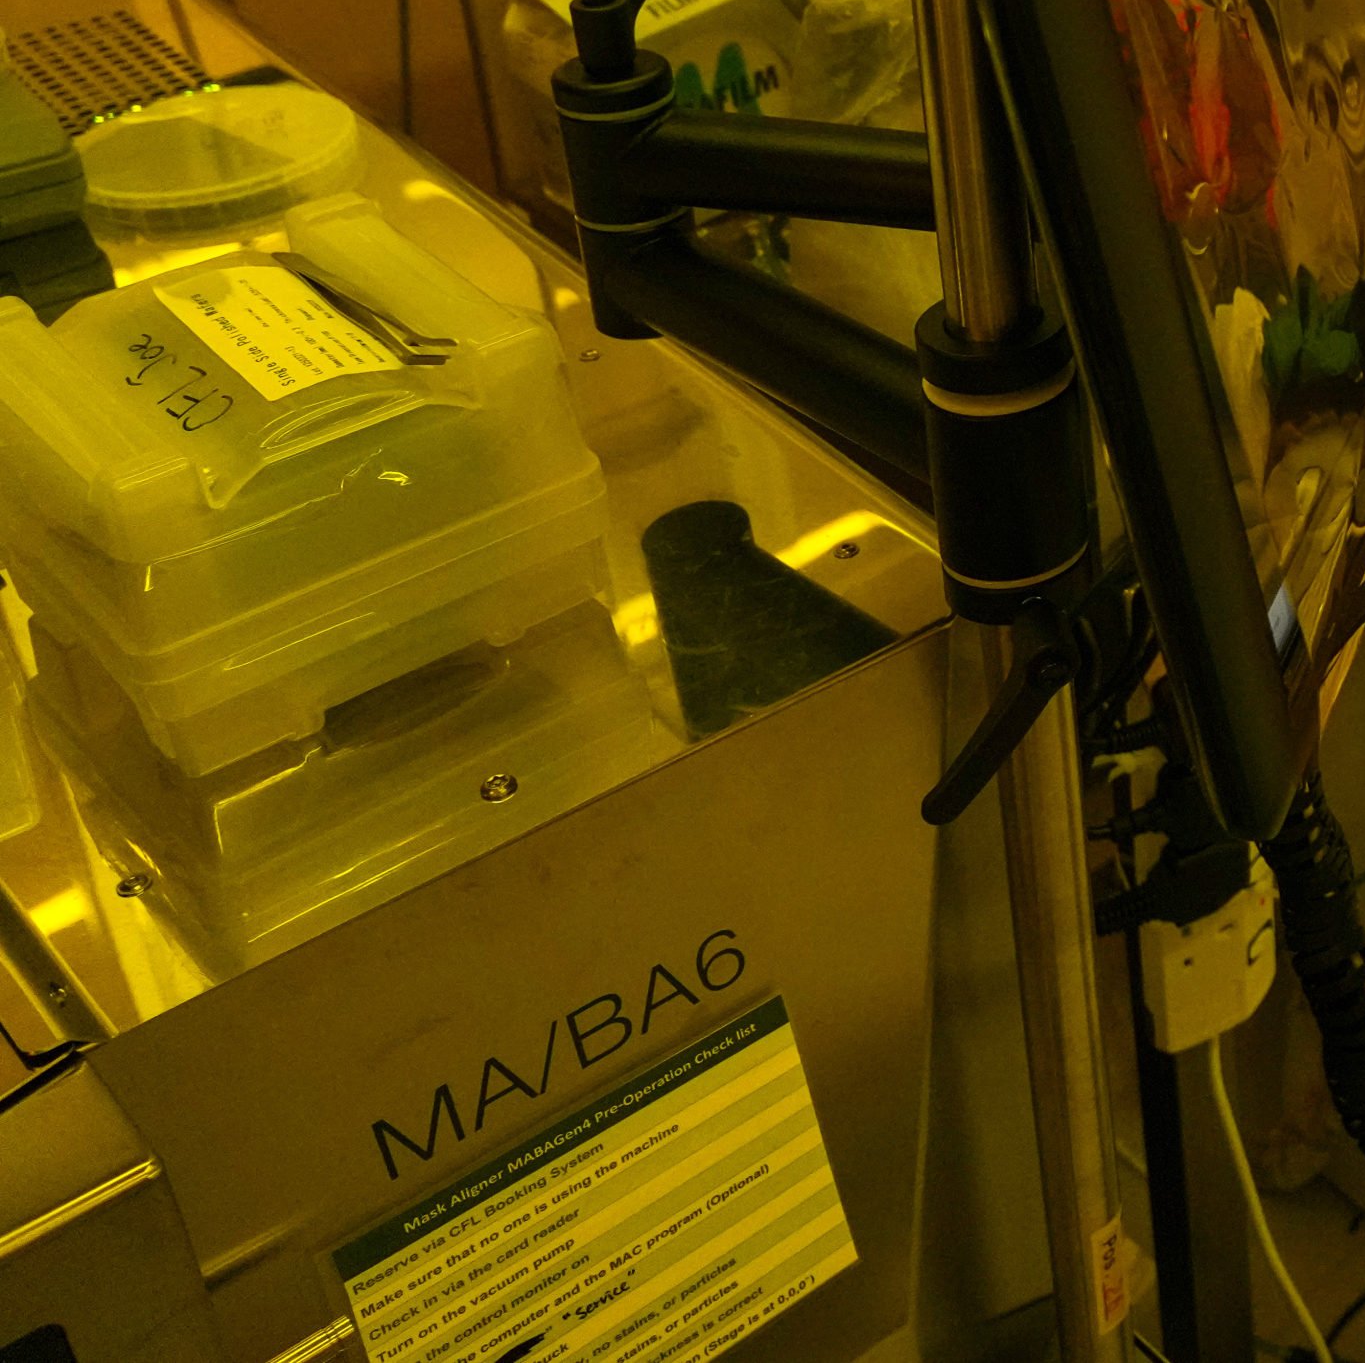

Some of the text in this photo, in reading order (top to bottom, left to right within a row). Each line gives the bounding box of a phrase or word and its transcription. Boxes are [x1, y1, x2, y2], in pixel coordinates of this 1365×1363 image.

[125, 333, 234, 432] CFL Joe
[220, 315, 248, 348] Polished
[249, 344, 270, 364] Side
[267, 360, 296, 387] Single
[370, 928, 746, 1180] MA/BA6
[403, 1022, 757, 1234] Mask Aligner MABAGen4 Pre-Operation Check list
[352, 1141, 605, 1296] Reserve via CFL Booking System
[360, 1122, 680, 1319] Make sure that no one is using the machine
[480, 1305, 551, 1354] computer
[554, 1283, 581, 1308] and
[583, 1267, 608, 1288] the
[609, 1245, 644, 1272] MAC
[646, 1208, 703, 1251] program
[705, 1163, 770, 1212] (Optional)
[369, 1207, 581, 1342] Check in via the card reader
[374, 1237, 576, 1363] Turn on the vacuum pump
[425, 1252, 590, 1361] the control monitor on
[592, 1257, 738, 1358] no stains, or particles
[616, 1280, 740, 1363] stains, or particles
[647, 1286, 764, 1363] ckness is correct
[704, 1322, 746, 1358] (Stage
[748, 1312, 760, 1326] is
[763, 1300, 776, 1316] at
